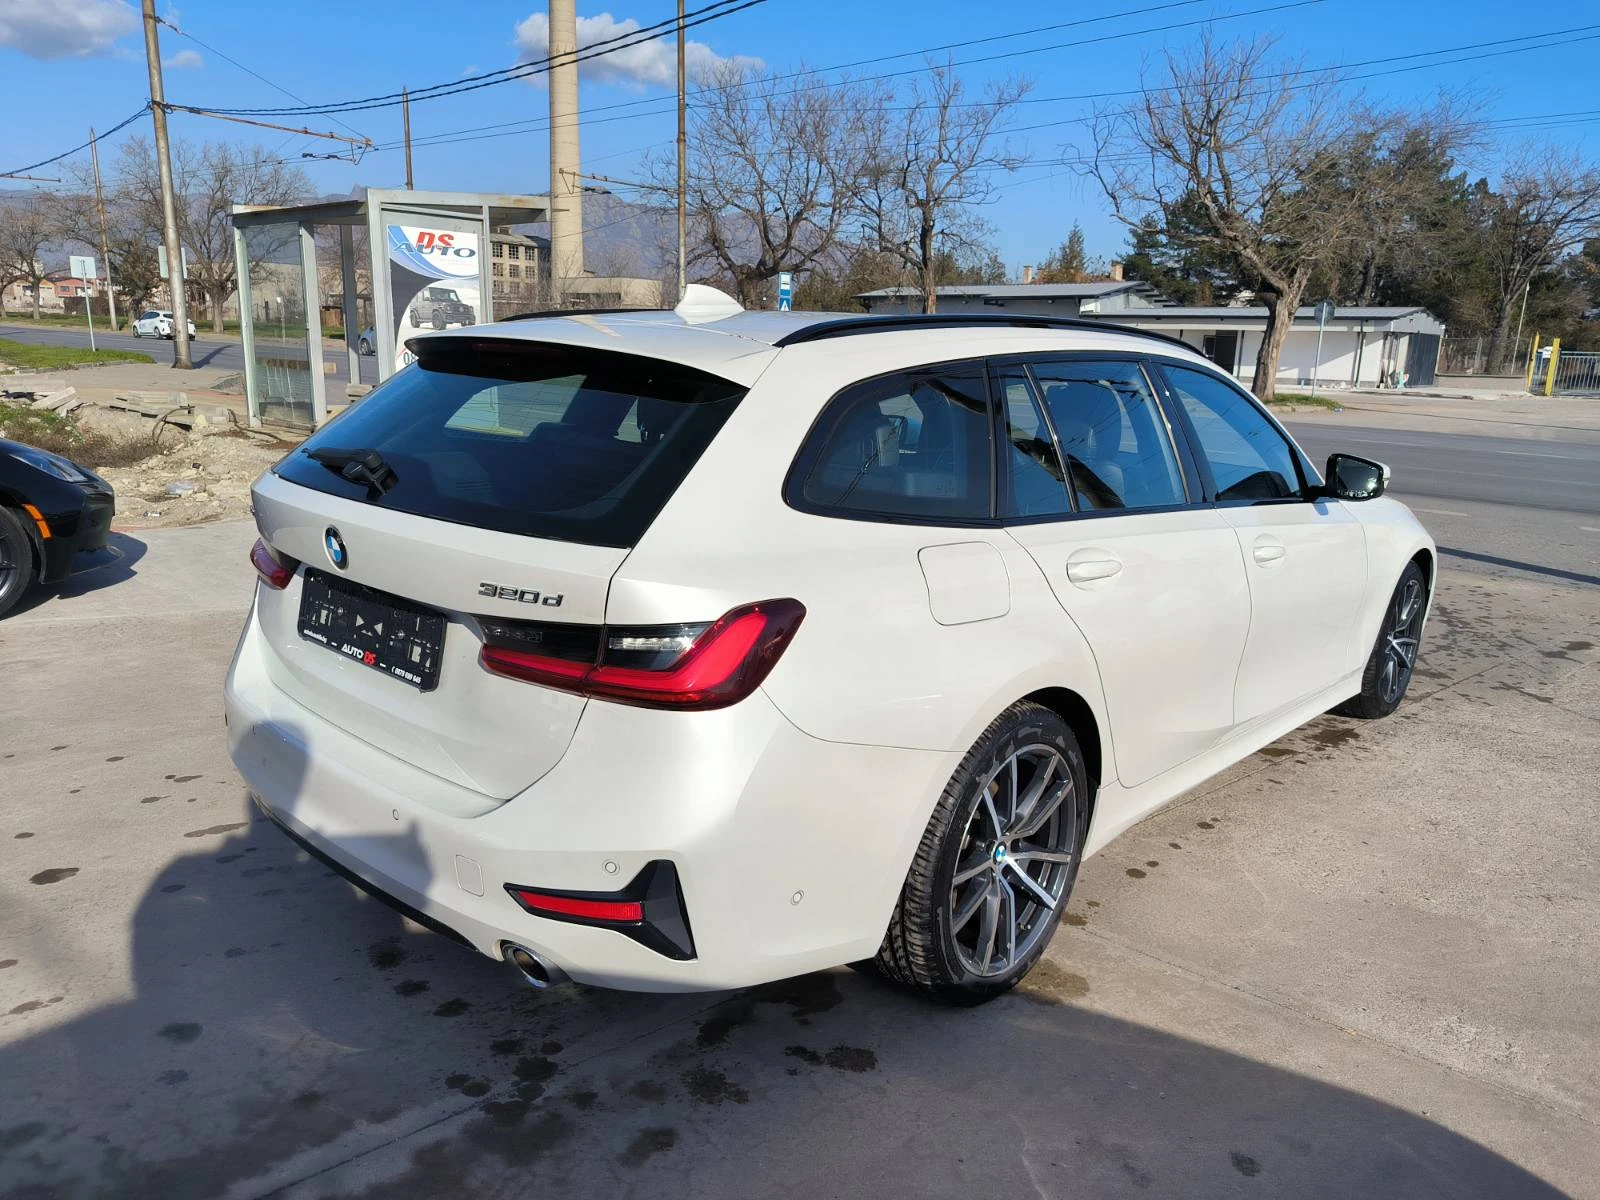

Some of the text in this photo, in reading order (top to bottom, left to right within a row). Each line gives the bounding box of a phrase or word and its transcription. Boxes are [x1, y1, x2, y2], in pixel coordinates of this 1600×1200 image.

[393, 241, 476, 258] AUTO
[478, 581, 564, 608] 320d
[341, 643, 364, 659] AUTO
[363, 650, 376, 666] DS
